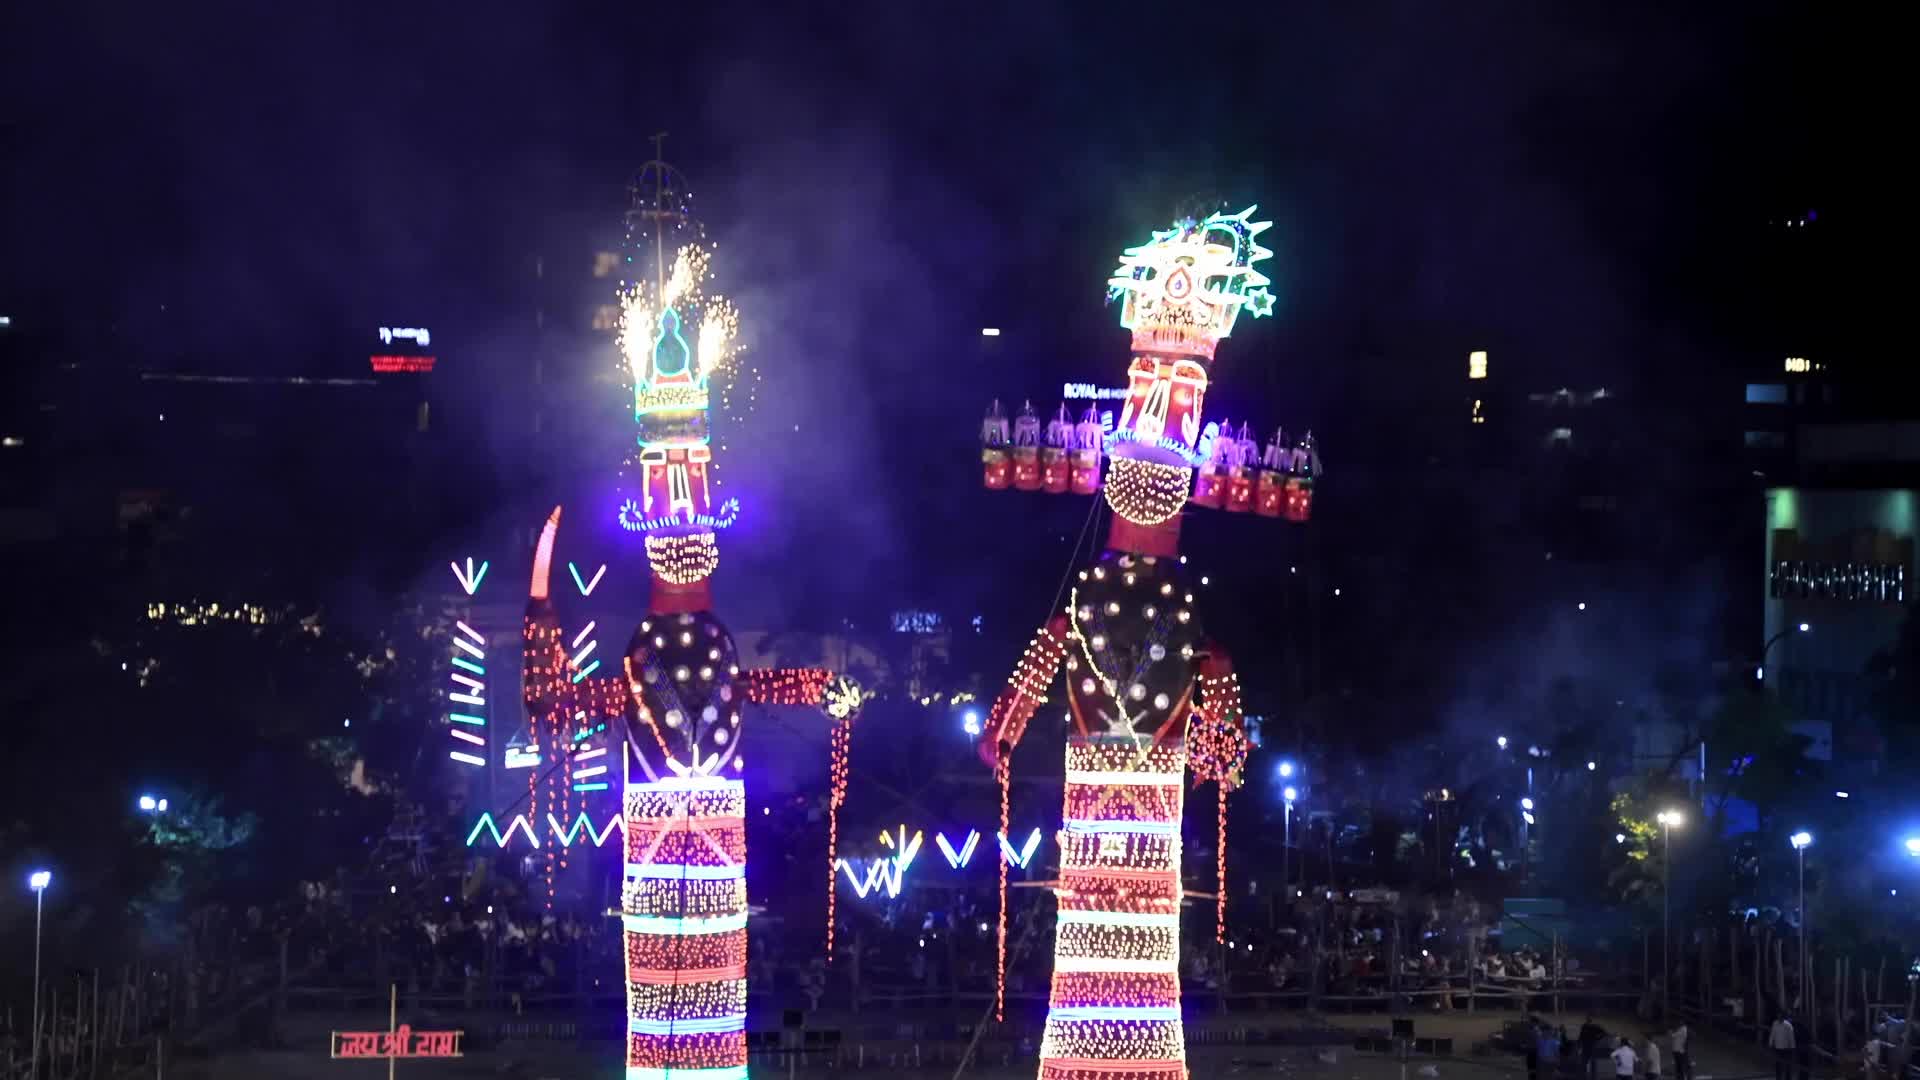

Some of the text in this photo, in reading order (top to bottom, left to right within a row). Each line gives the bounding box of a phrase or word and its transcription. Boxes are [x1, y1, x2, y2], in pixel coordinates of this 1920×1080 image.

[1063, 382, 1098, 399] ROYAL
[340, 1024, 454, 1057] जय श्री राम
